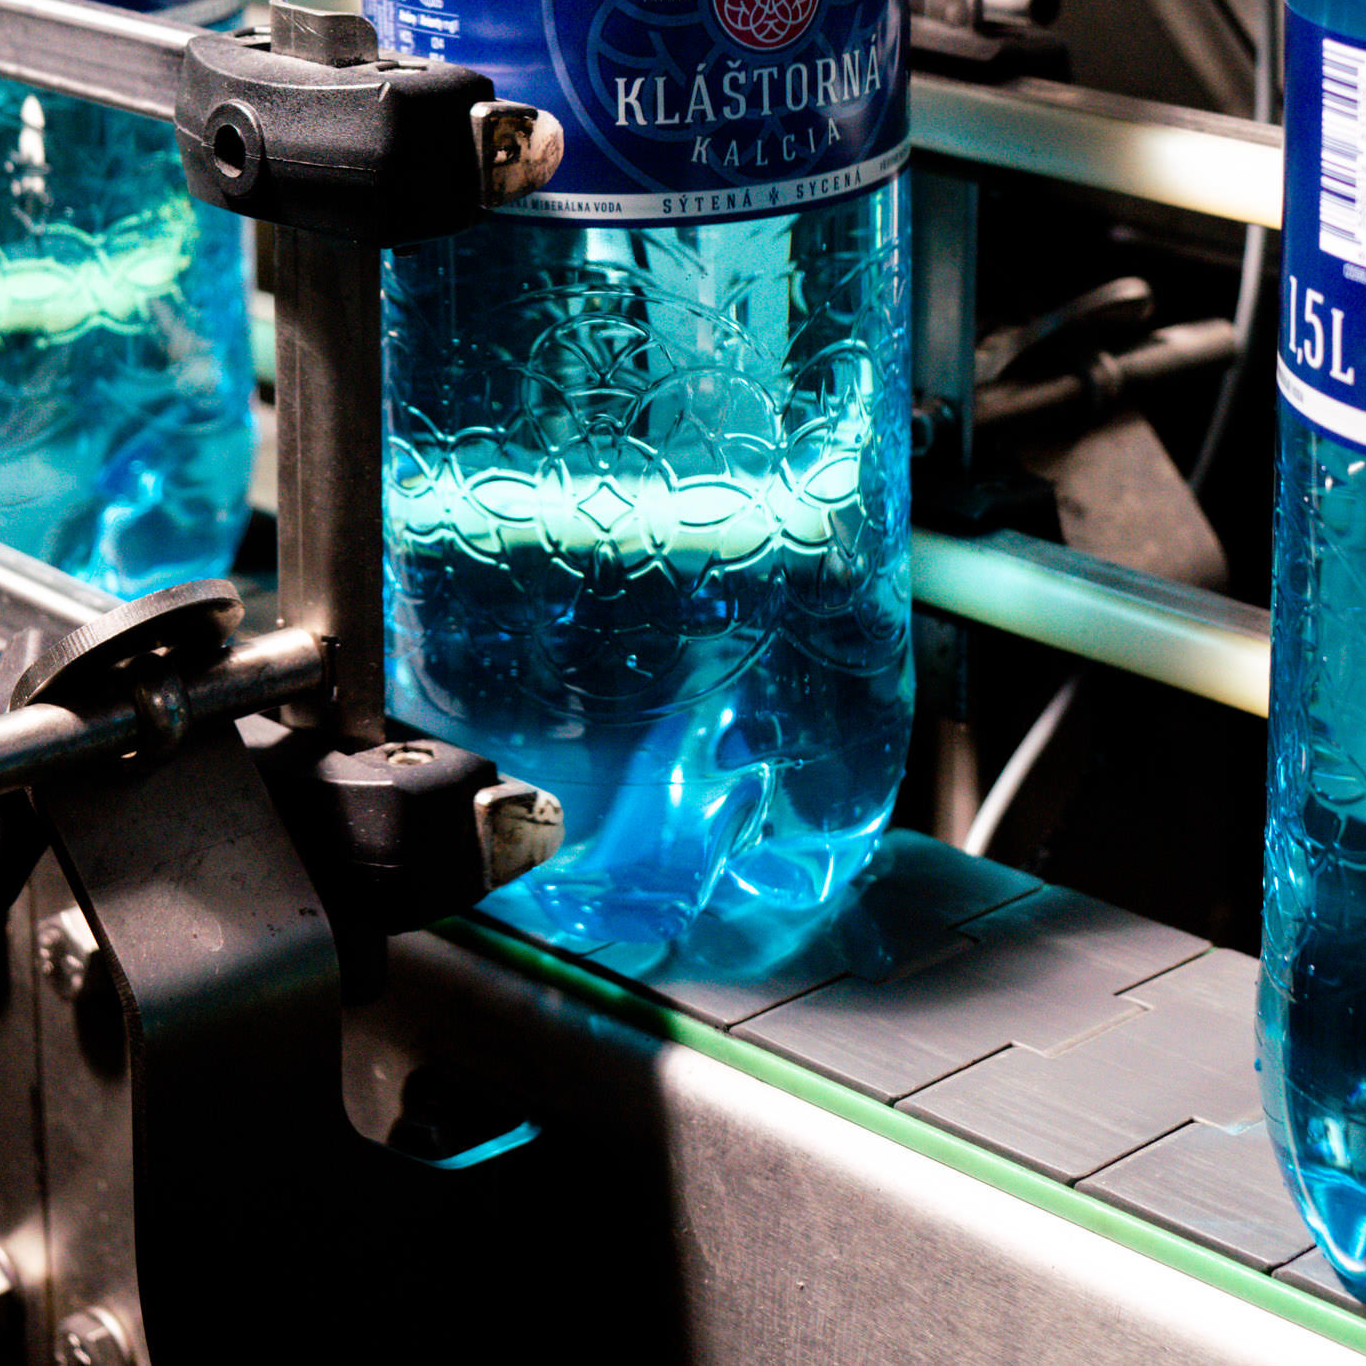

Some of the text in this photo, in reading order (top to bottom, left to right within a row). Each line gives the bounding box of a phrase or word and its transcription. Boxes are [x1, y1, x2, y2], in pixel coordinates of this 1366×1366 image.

[614, 33, 882, 126] KLÁŠTORNÁ
[691, 116, 841, 166] KALCIA
[593, 201, 623, 213] VODA
[662, 167, 864, 215] SÝTENÁ SYCENÁ
